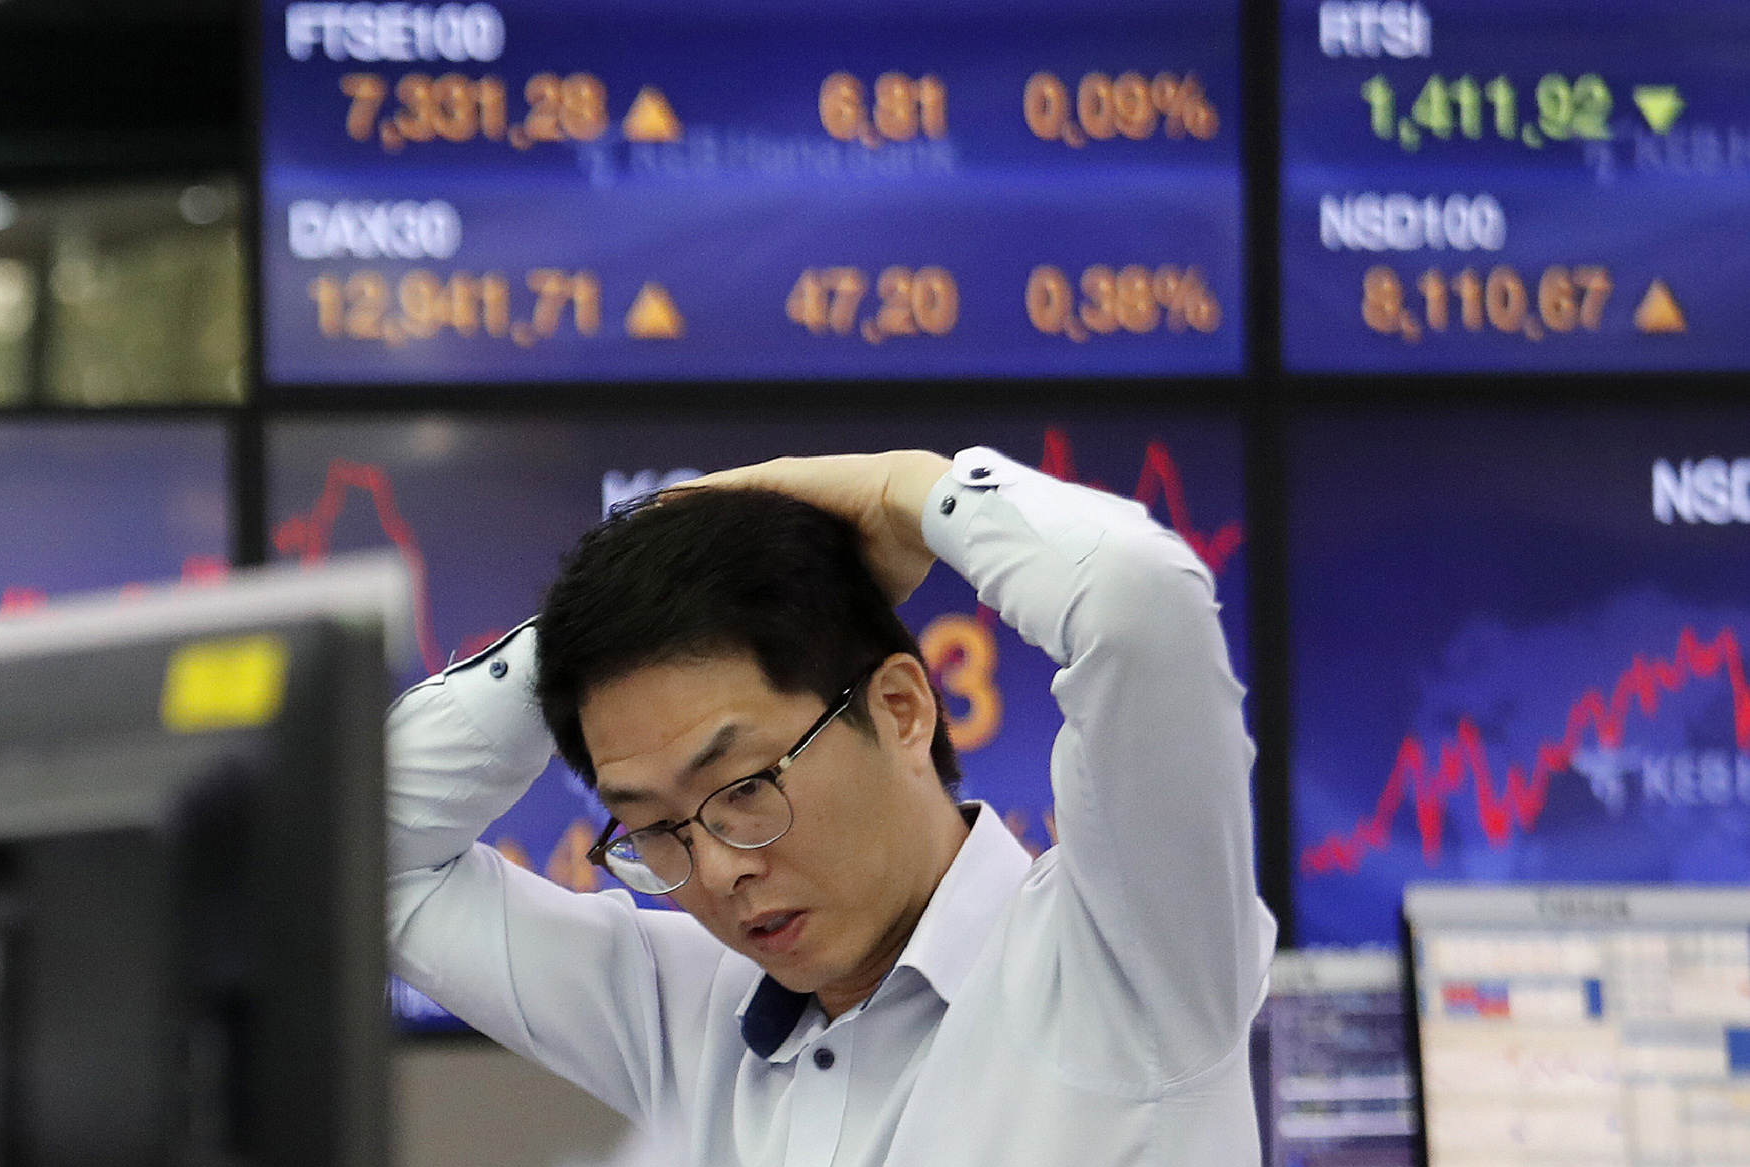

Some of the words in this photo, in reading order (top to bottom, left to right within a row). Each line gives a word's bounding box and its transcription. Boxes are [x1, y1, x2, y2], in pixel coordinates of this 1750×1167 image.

[286, 2, 505, 61] FTSE100
[1319, 0, 1431, 58] RTSI
[288, 201, 461, 258] DAX30
[1319, 192, 1506, 251] NSD100
